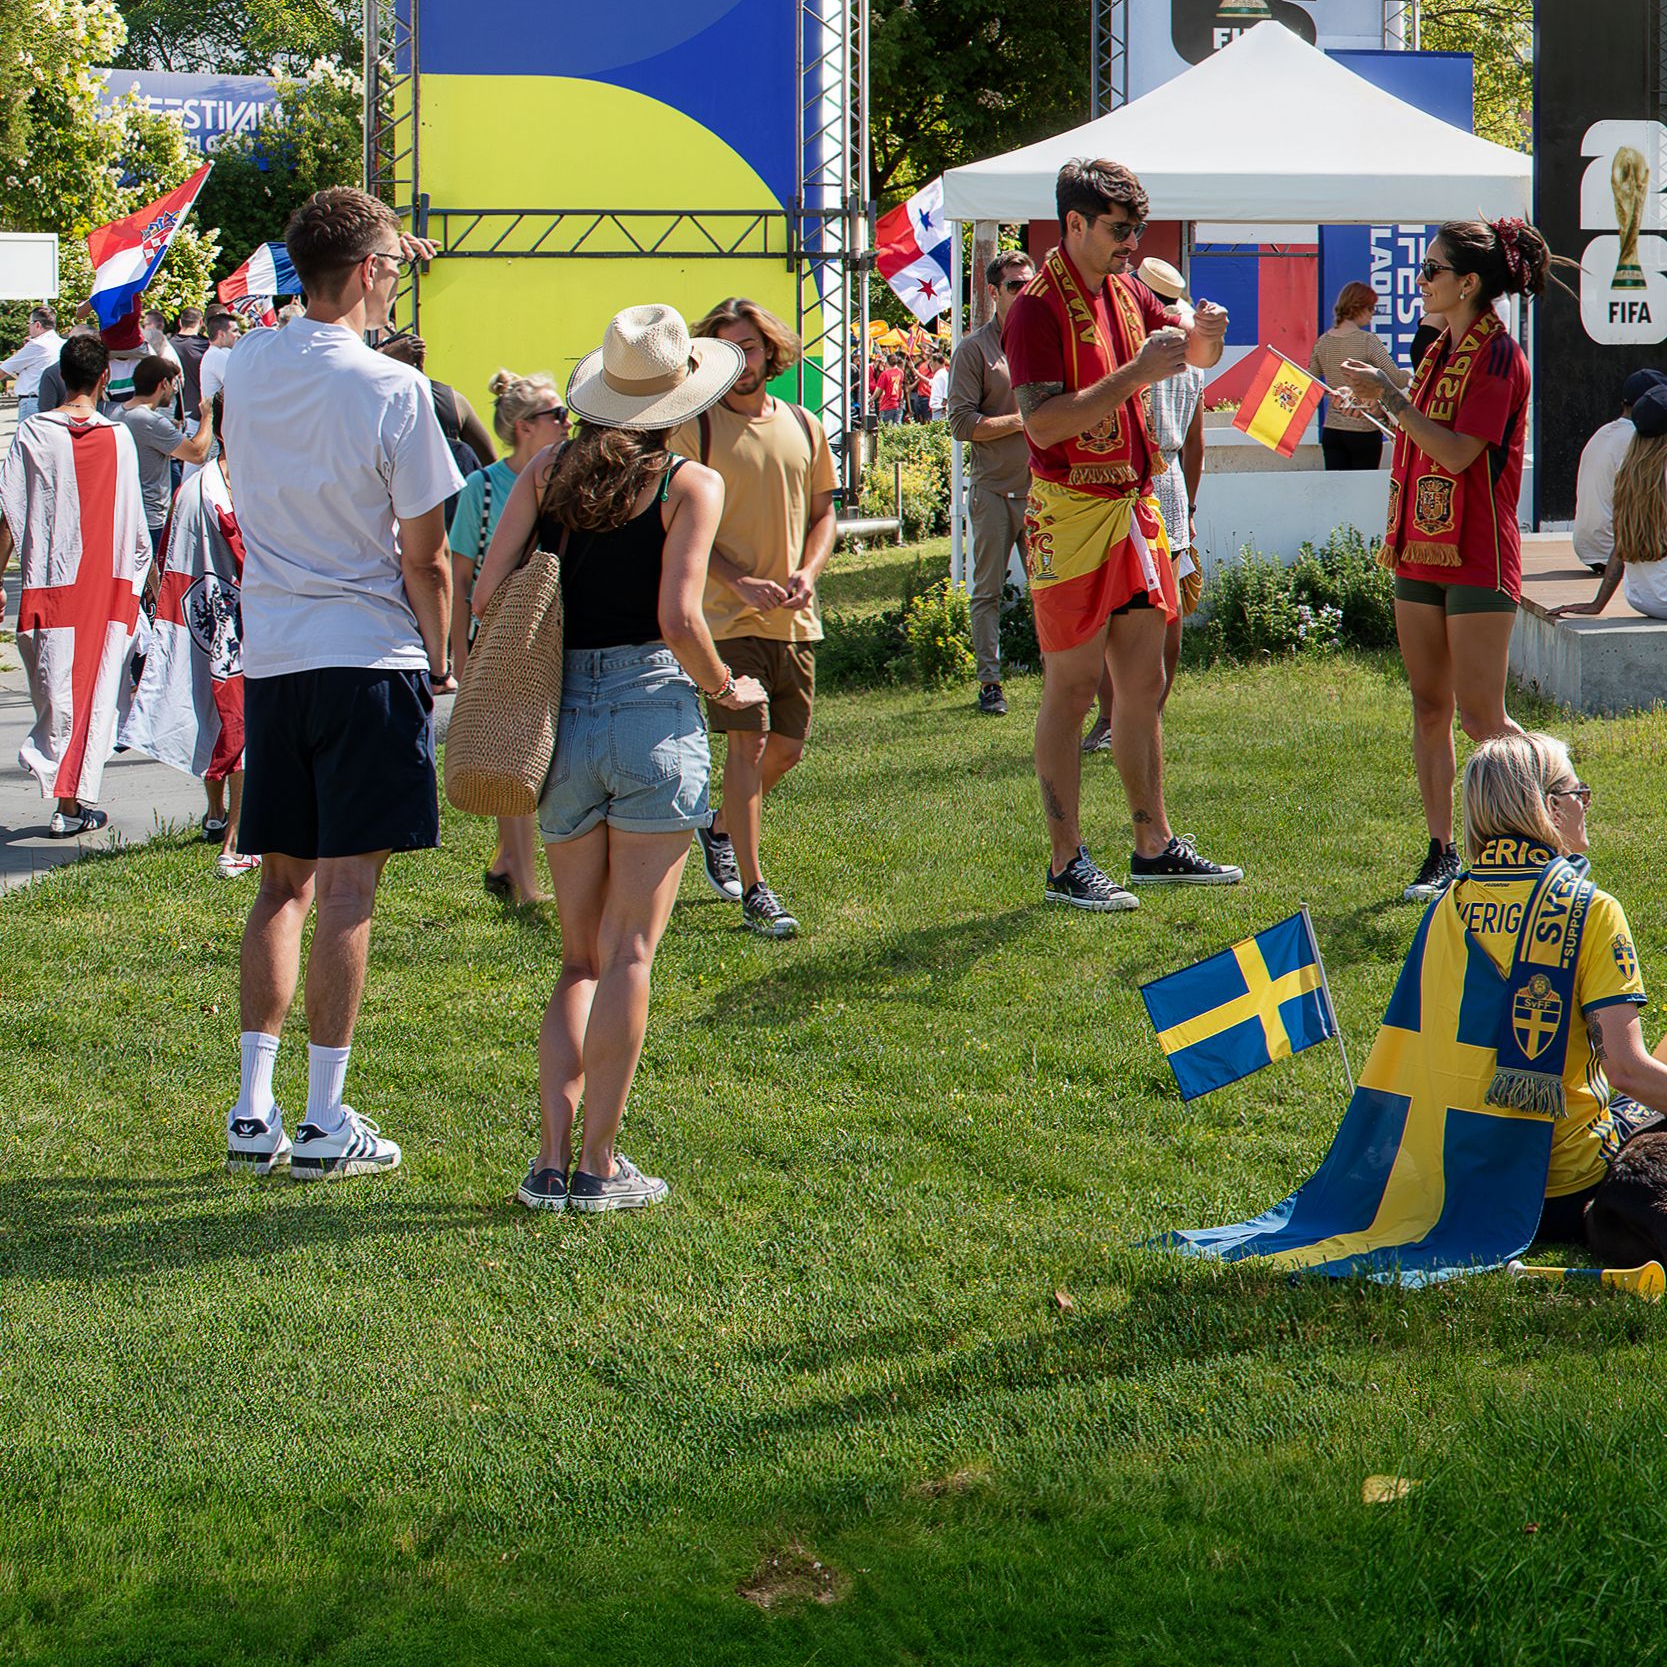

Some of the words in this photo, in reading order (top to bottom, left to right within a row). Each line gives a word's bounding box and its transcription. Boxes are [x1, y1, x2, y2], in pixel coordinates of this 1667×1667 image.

[1212, 27, 1251, 50] FI
[1607, 301, 1652, 324] FIFA
[1475, 838, 1549, 866] ERIG
[1523, 998, 1552, 1010] SvFF
